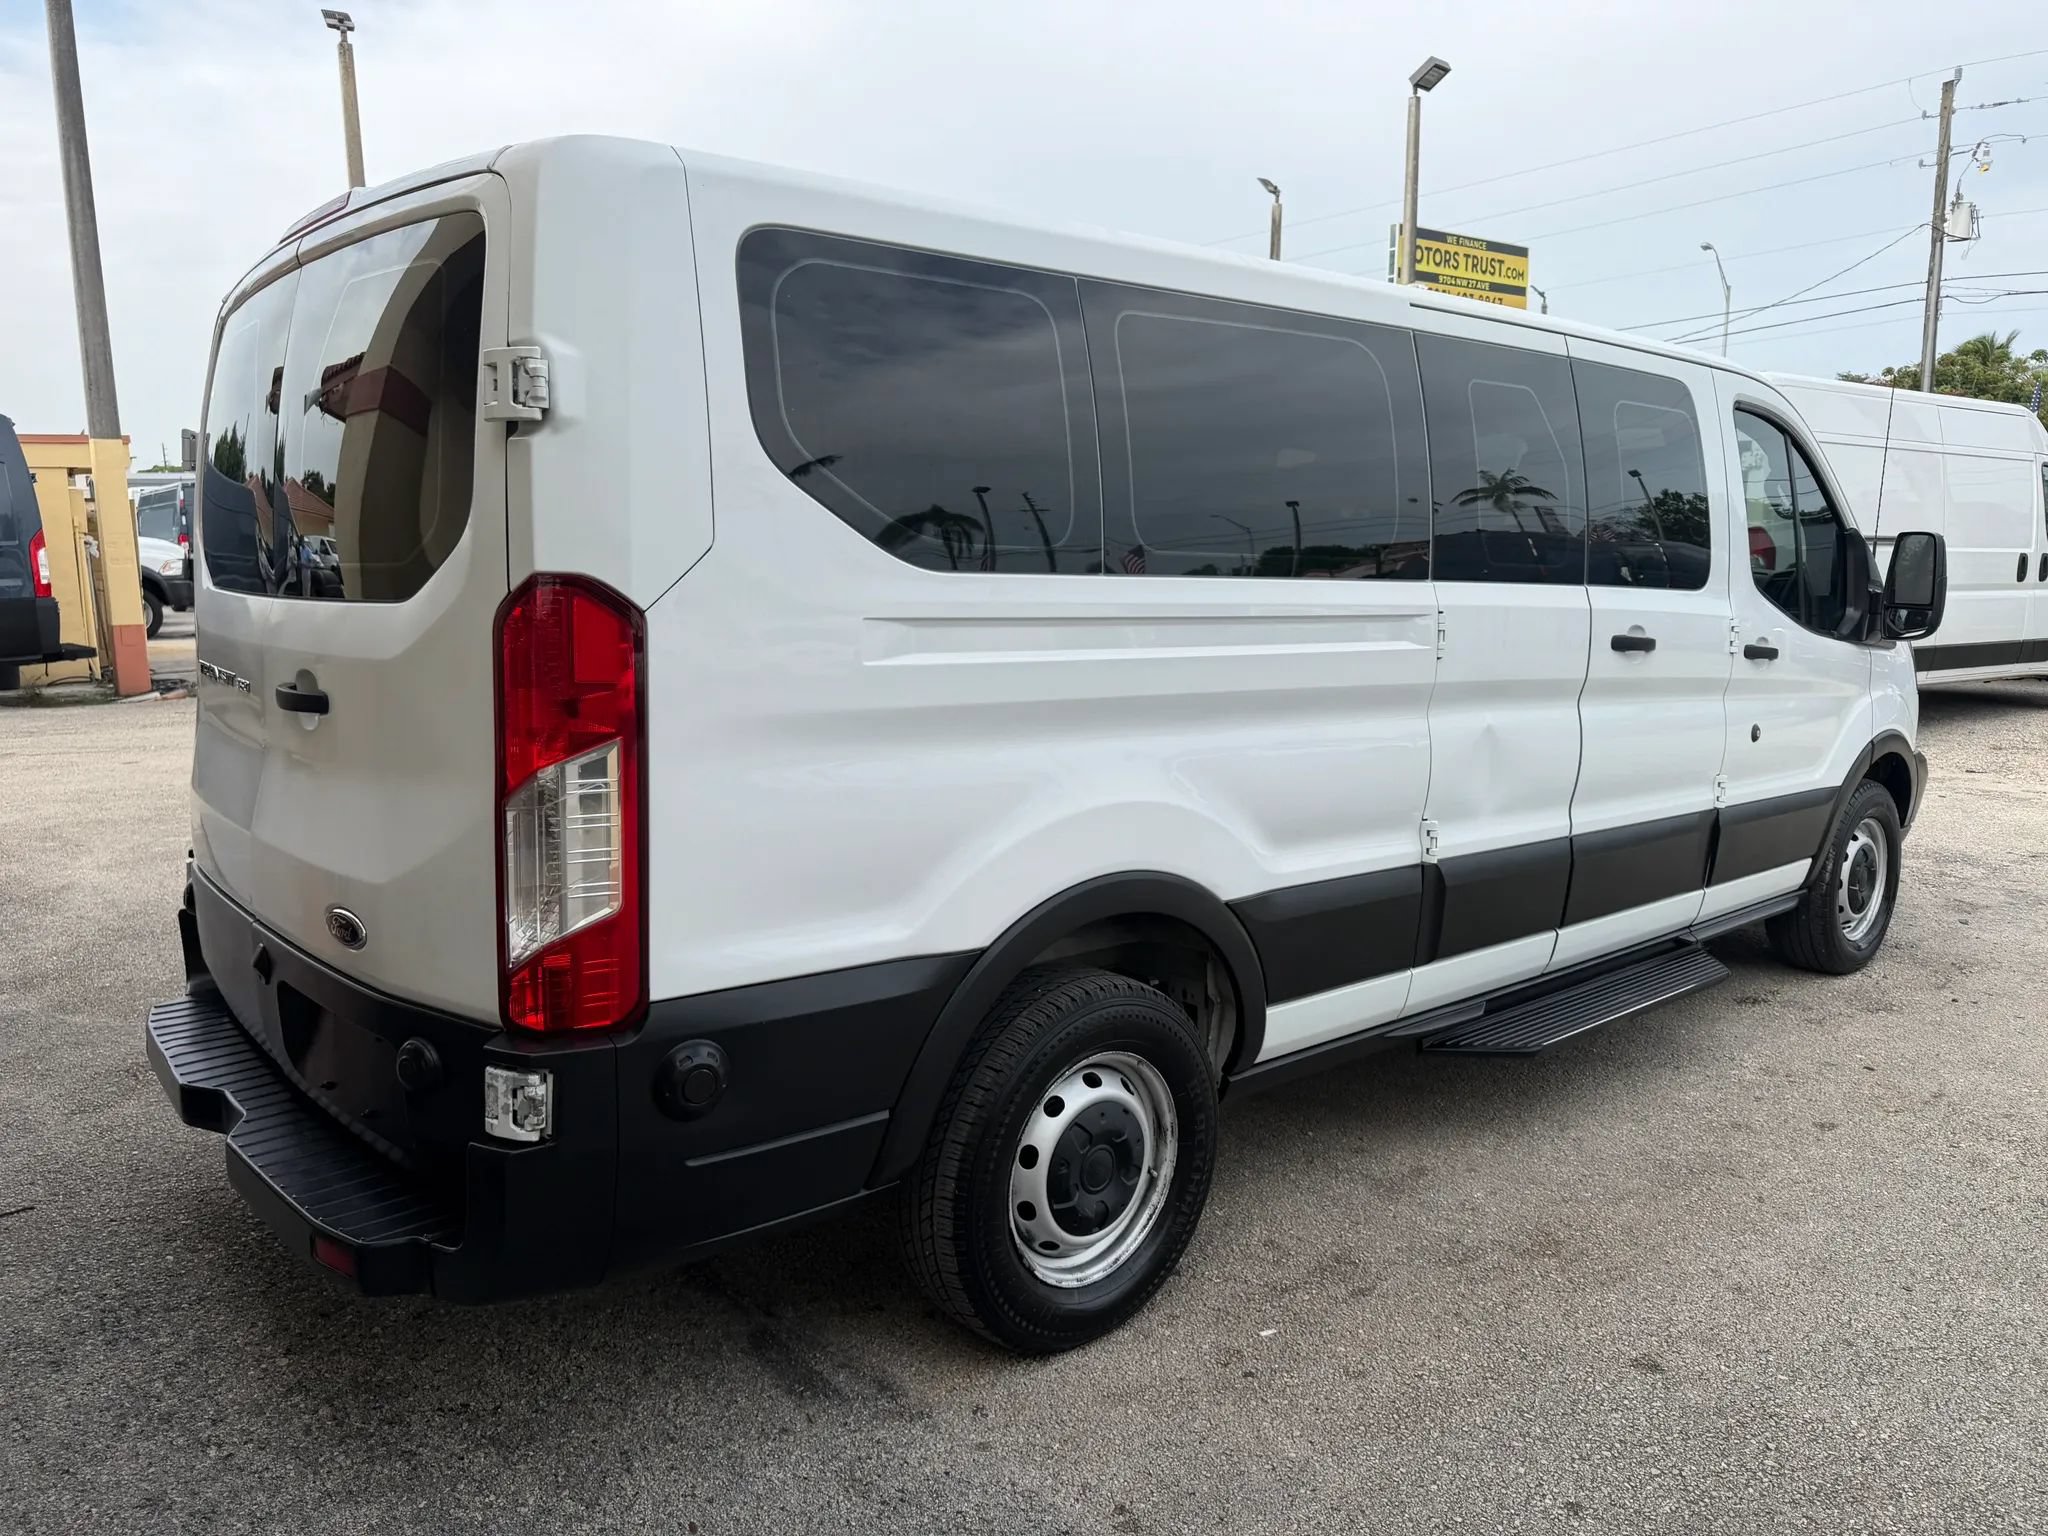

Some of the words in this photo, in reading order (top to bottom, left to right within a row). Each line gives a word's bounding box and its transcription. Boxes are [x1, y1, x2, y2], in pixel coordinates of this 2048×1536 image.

[1446, 235, 1458, 245] WE
[1459, 236, 1487, 250] FINANCE
[1415, 244, 1460, 270] OTORS
[1438, 275, 1456, 285] 9704
[1456, 278, 1468, 287] NW
[1468, 280, 1477, 288] 27
[1476, 281, 1490, 291] AVE
